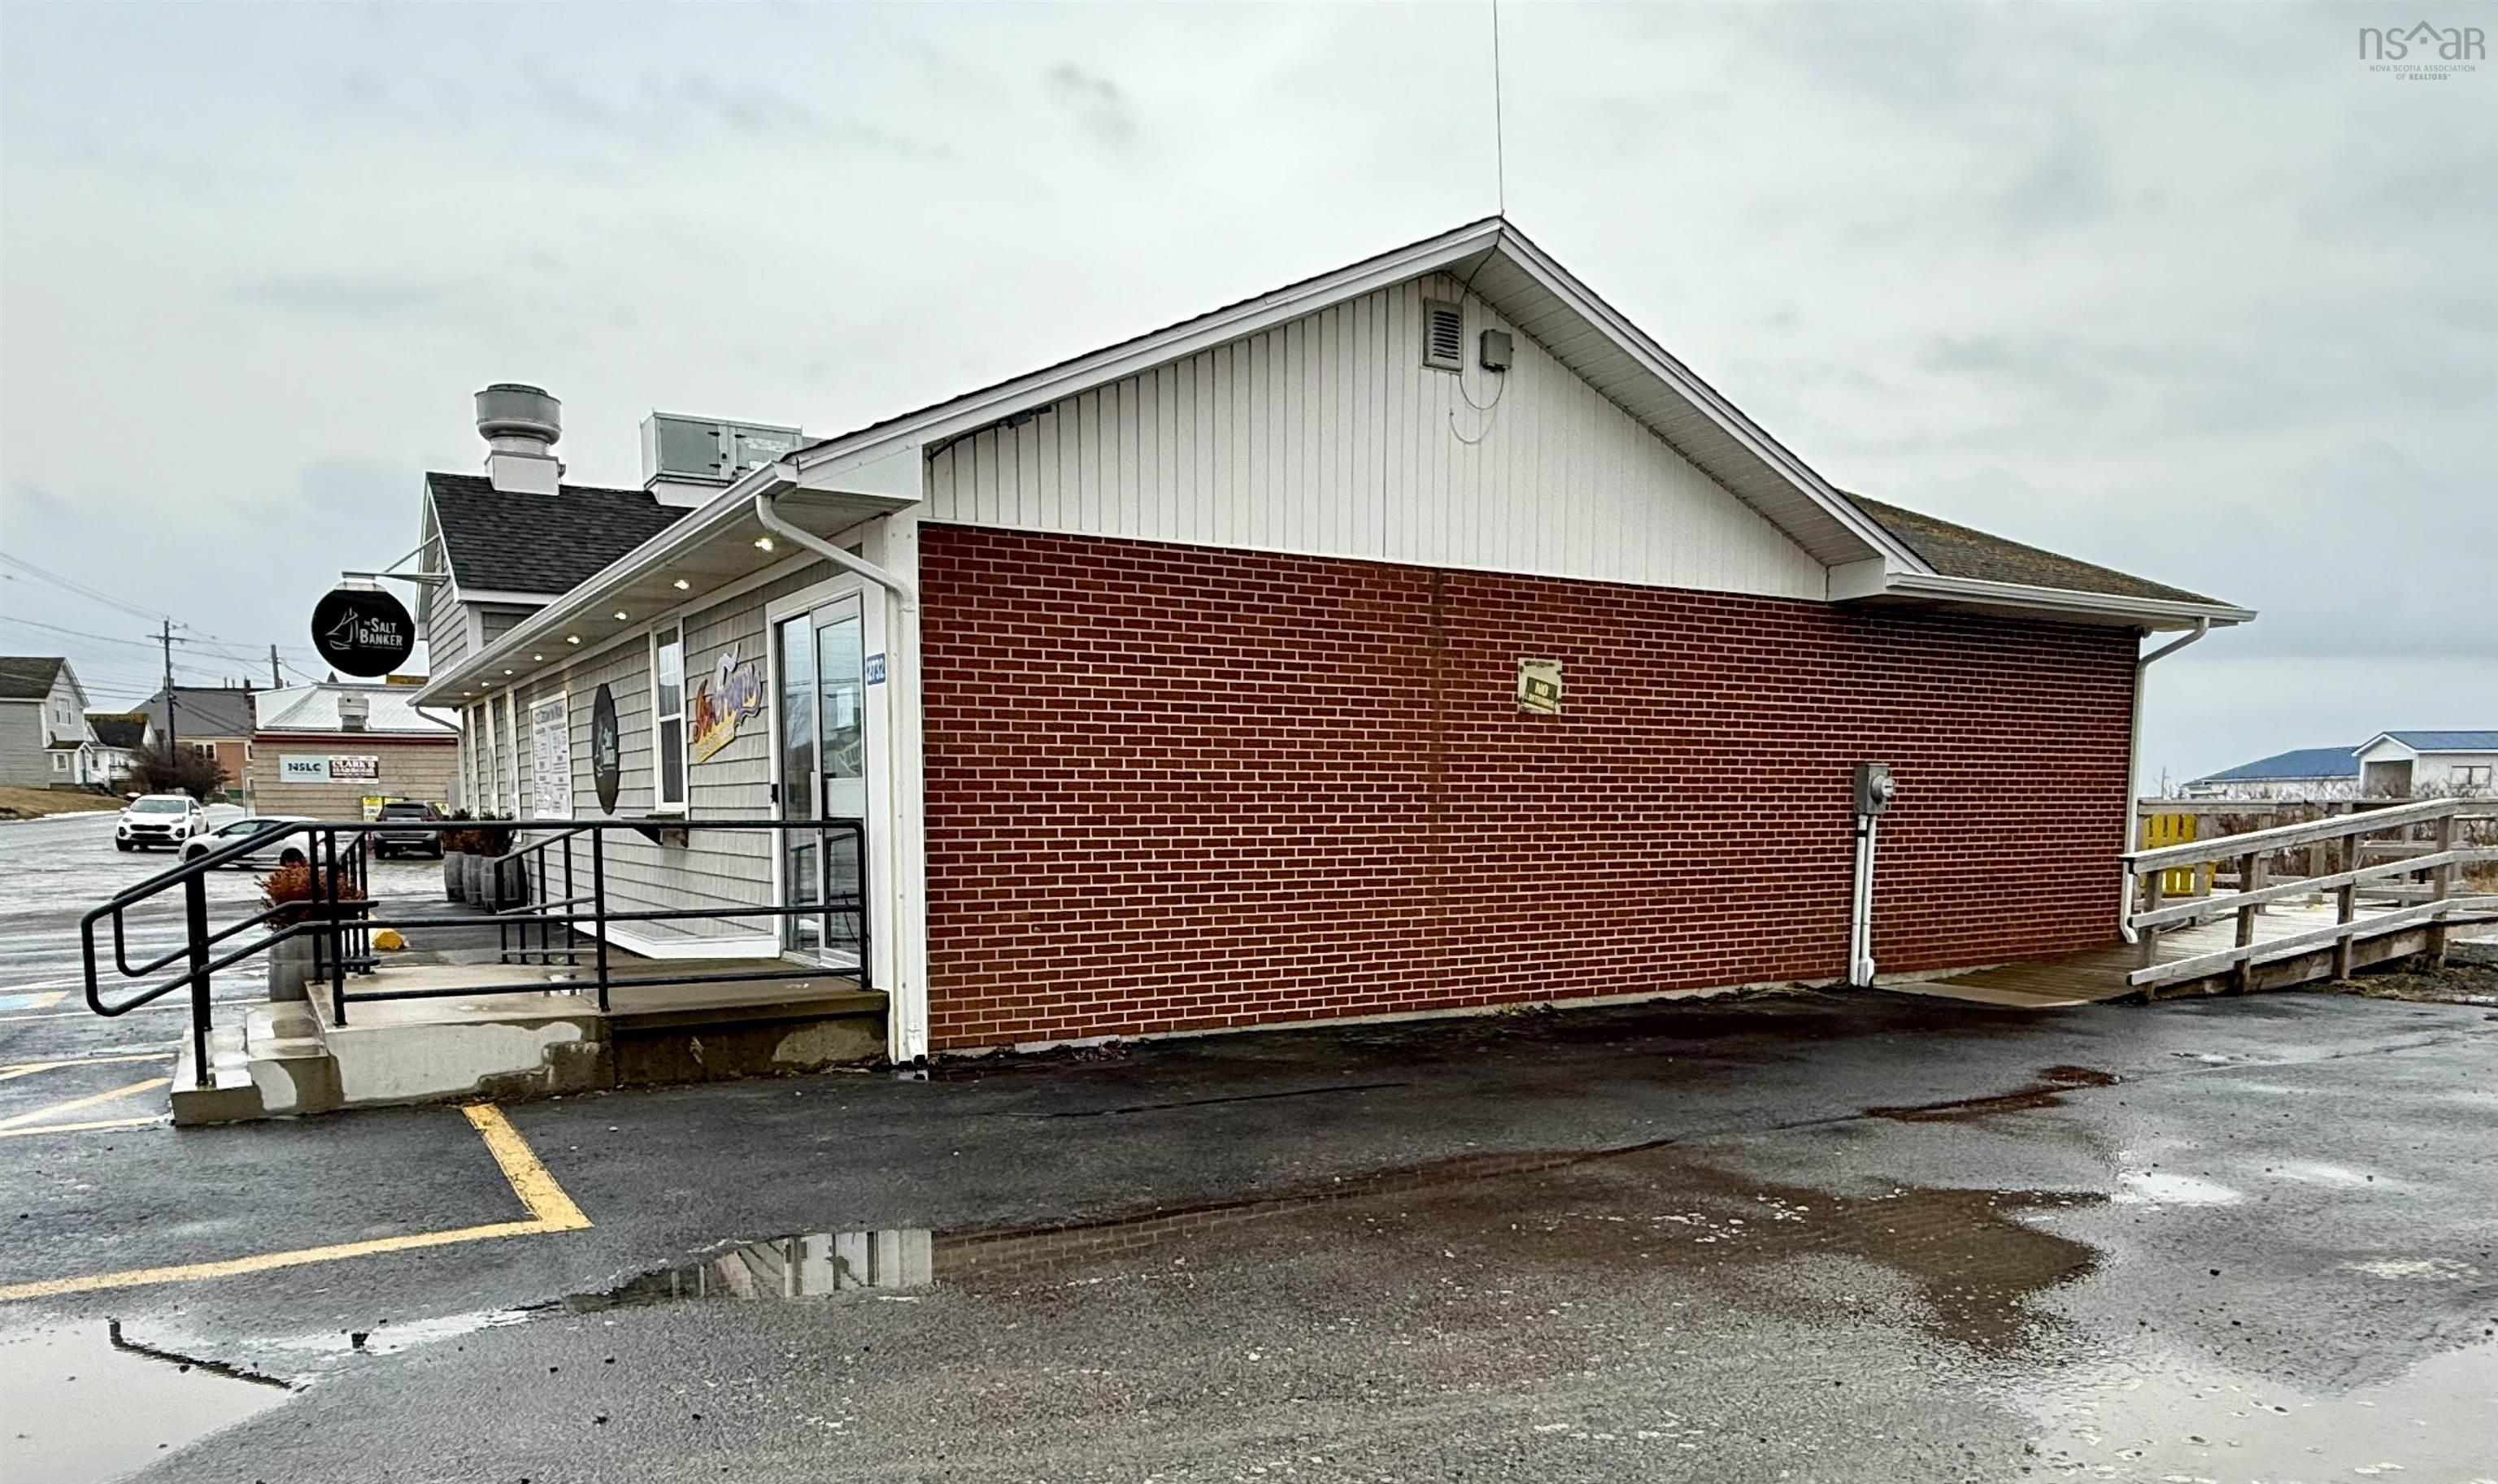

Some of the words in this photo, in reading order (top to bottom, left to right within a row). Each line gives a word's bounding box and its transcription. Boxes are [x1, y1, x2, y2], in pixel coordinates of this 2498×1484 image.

[371, 617, 397, 633] SALT
[359, 629, 403, 646] BANKER
[288, 763, 322, 772] NSLC
